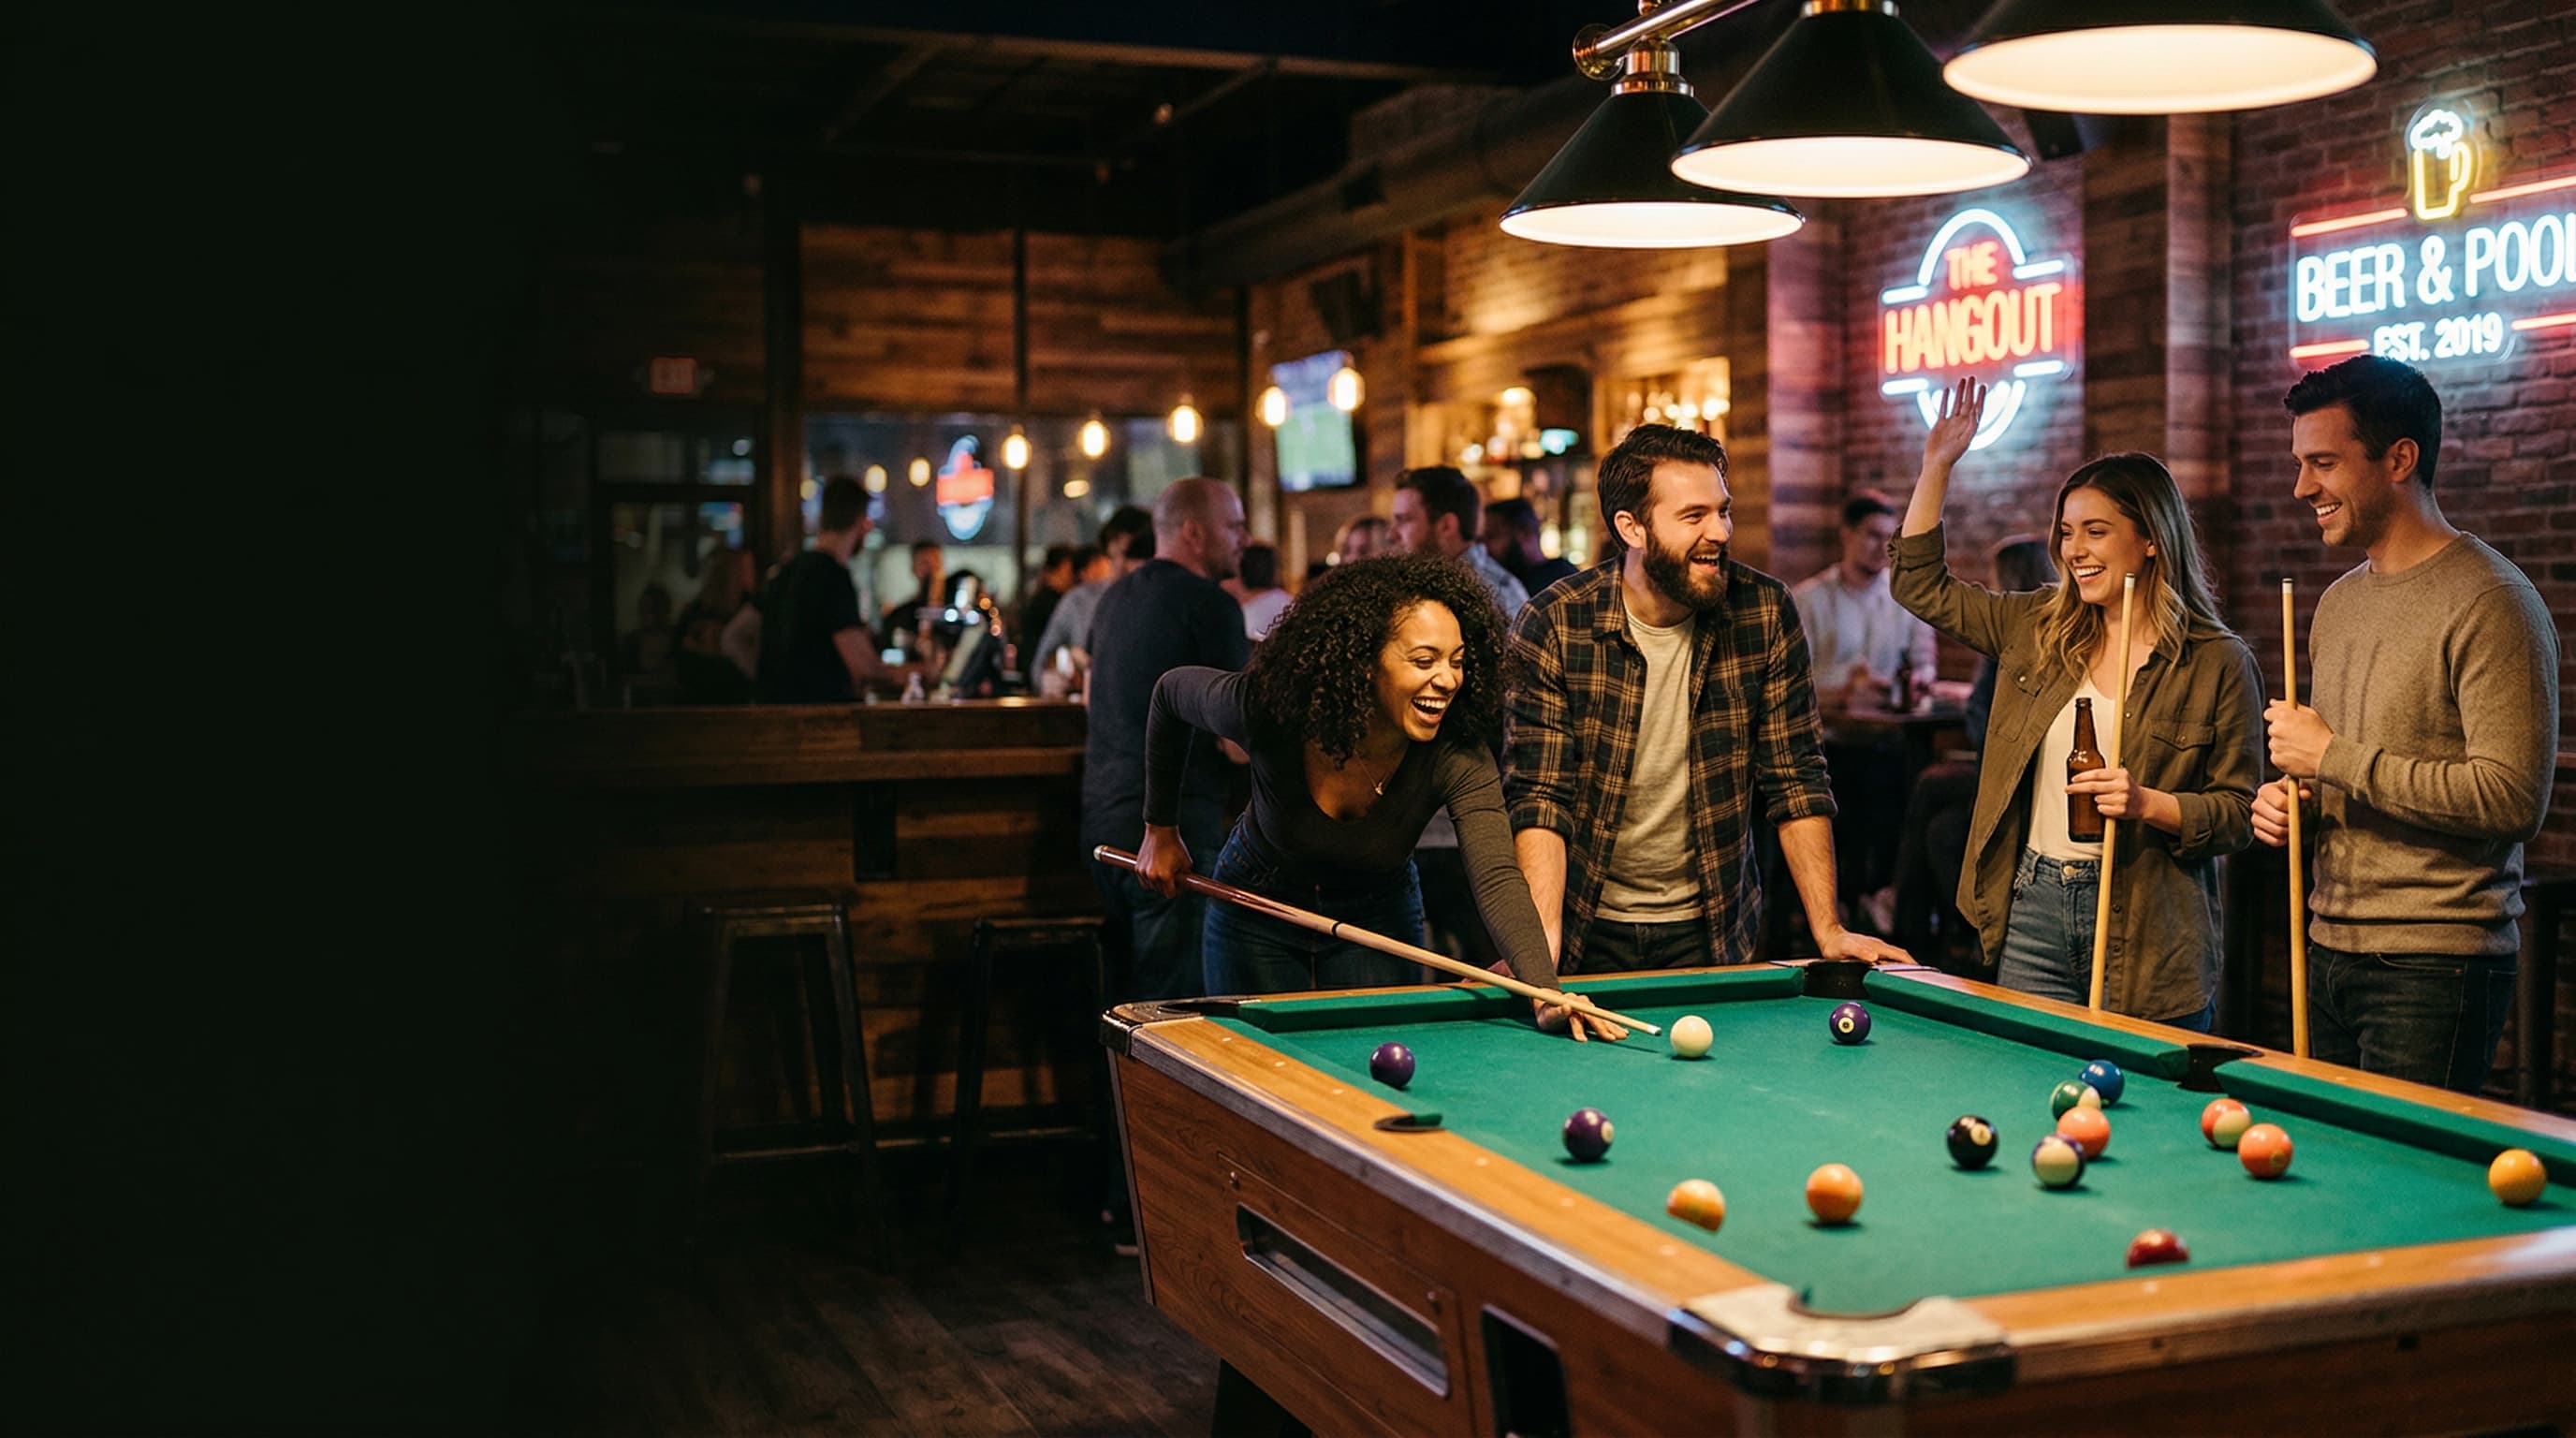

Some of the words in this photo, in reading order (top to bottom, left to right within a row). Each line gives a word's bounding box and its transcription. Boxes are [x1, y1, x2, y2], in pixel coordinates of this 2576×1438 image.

[1944, 241, 1998, 291] THE
[2296, 243, 2407, 322] BEER
[2417, 235, 2454, 305] &
[1884, 282, 2062, 374] HANGOUT
[2373, 321, 2431, 362] EST.
[2434, 312, 2503, 359] 2019
